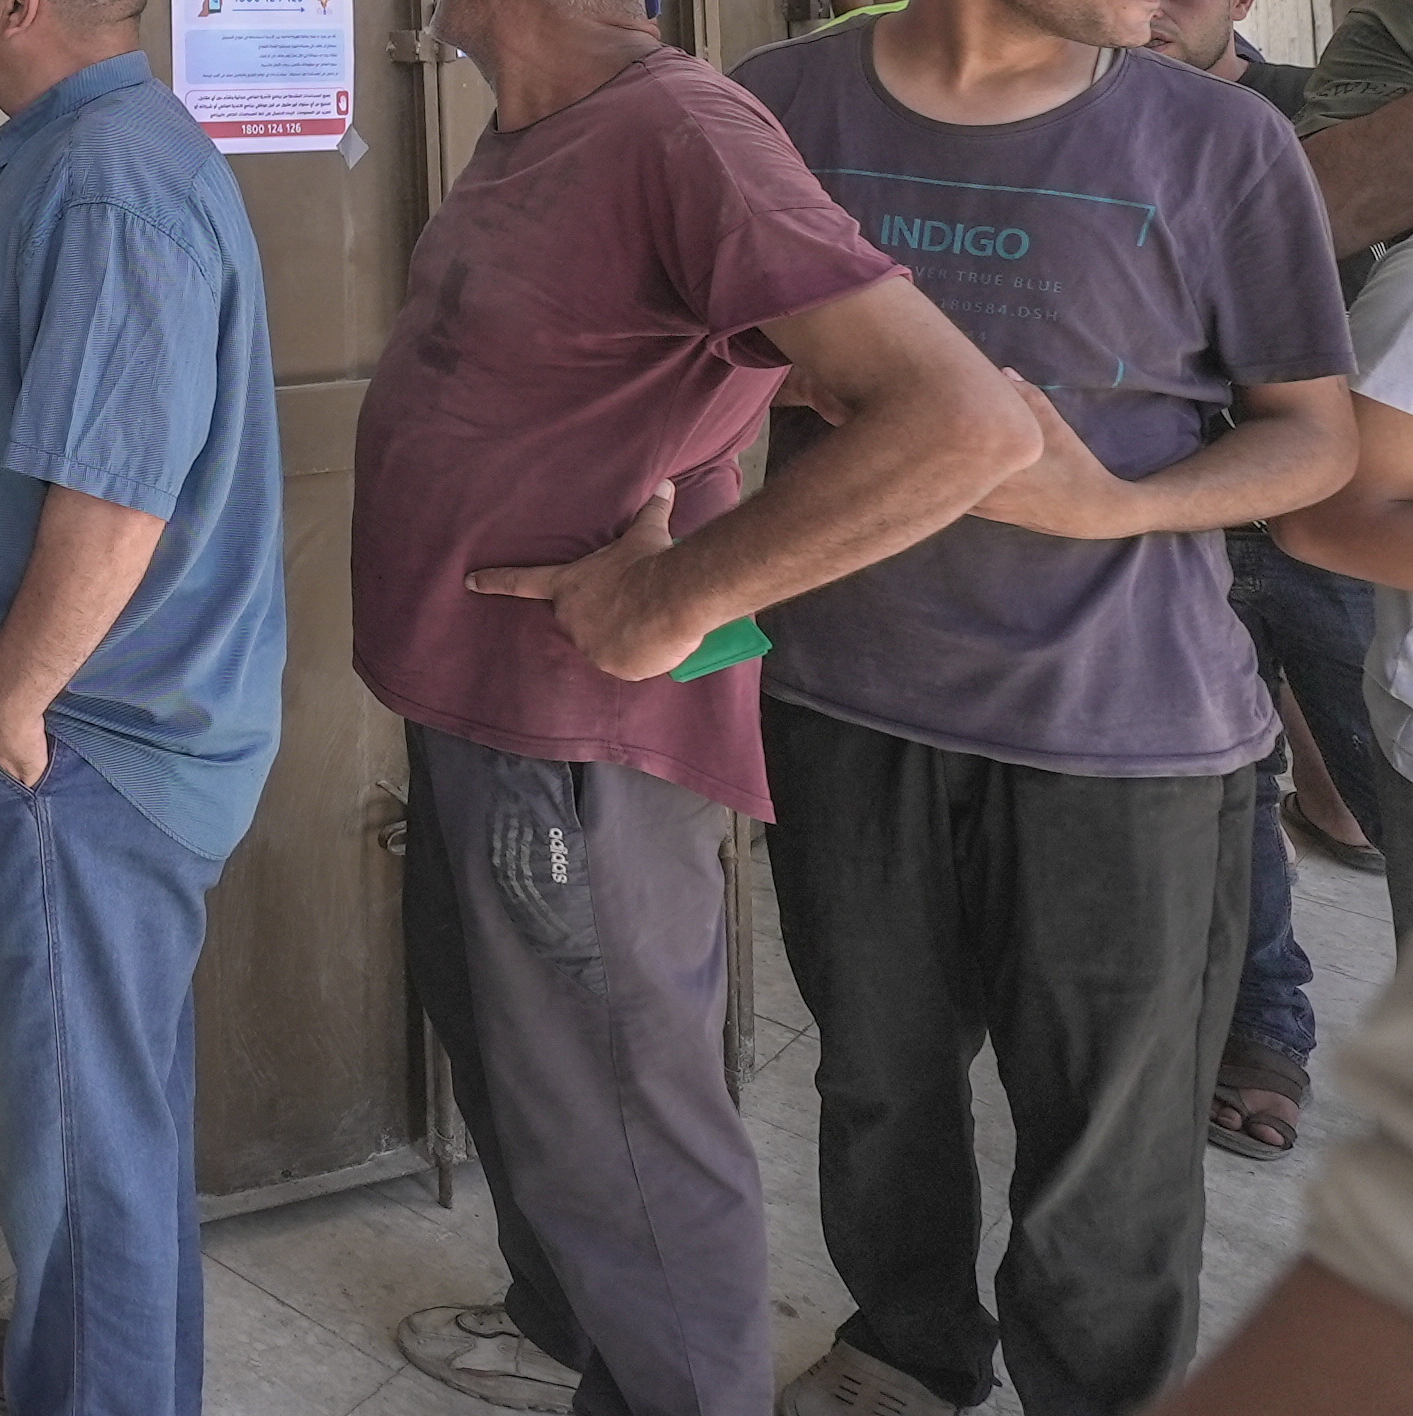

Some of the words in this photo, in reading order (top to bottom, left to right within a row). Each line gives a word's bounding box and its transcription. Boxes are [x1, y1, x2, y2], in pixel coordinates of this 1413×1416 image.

[242, 124, 264, 134] 1800
[268, 124, 283, 134] 124
[286, 123, 301, 133] 126
[881, 214, 1029, 260] INDIGO
[957, 271, 1003, 286] TRUE
[1015, 276, 1062, 293] BLUE
[549, 827, 569, 884] adidas
